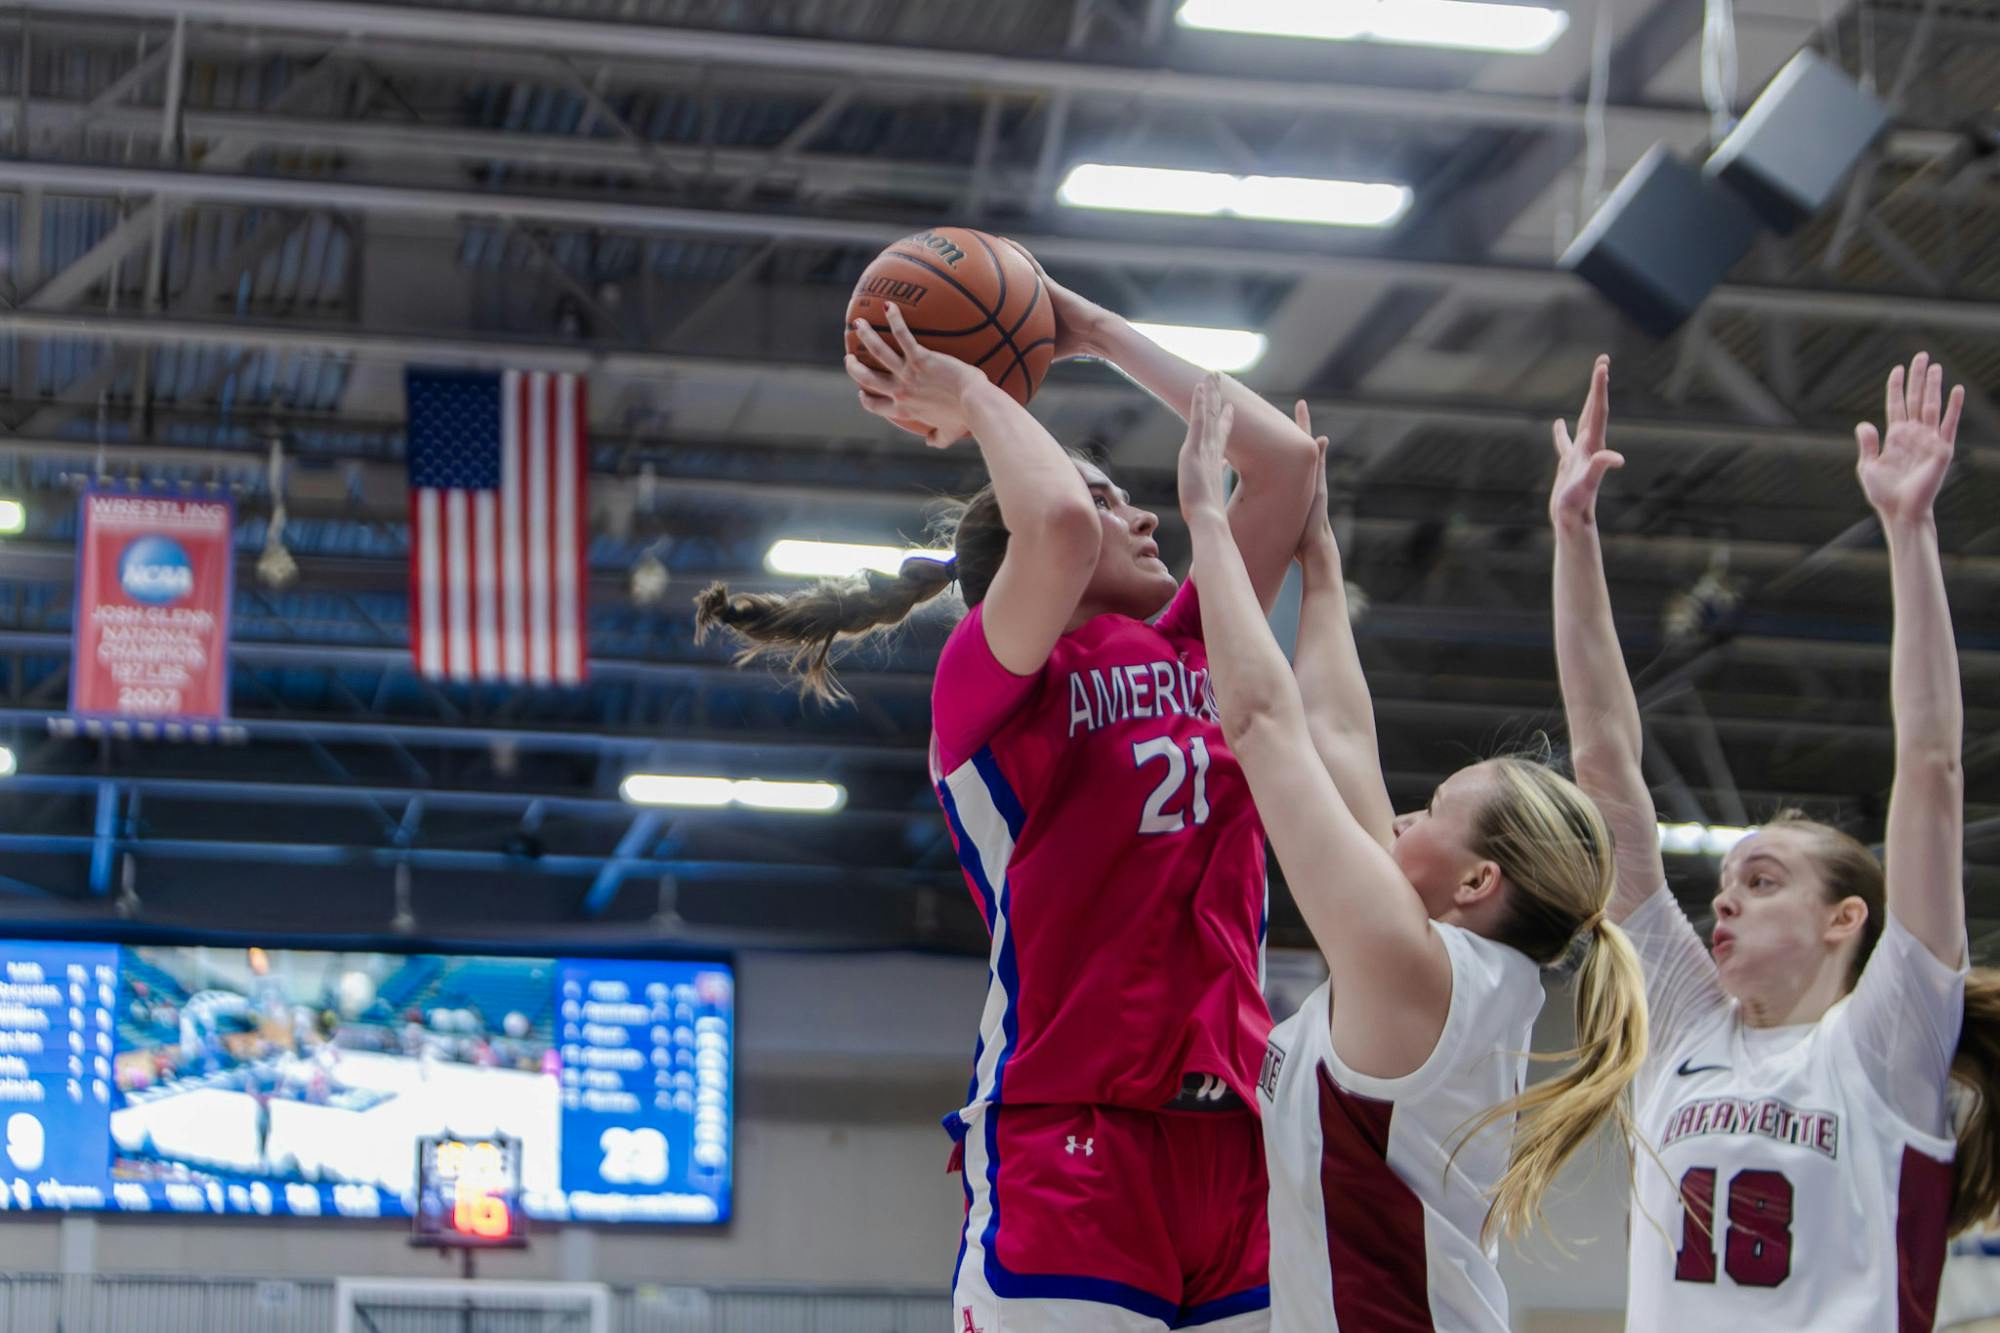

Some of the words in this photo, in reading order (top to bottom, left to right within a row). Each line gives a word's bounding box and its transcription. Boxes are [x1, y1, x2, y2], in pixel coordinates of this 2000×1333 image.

[91, 497, 227, 520] WRESTLING
[121, 563, 194, 592] NCAA
[1132, 735, 1211, 835] 21
[1661, 1098, 1838, 1158] LAFAYETTE
[1675, 1166, 1794, 1288] 18
